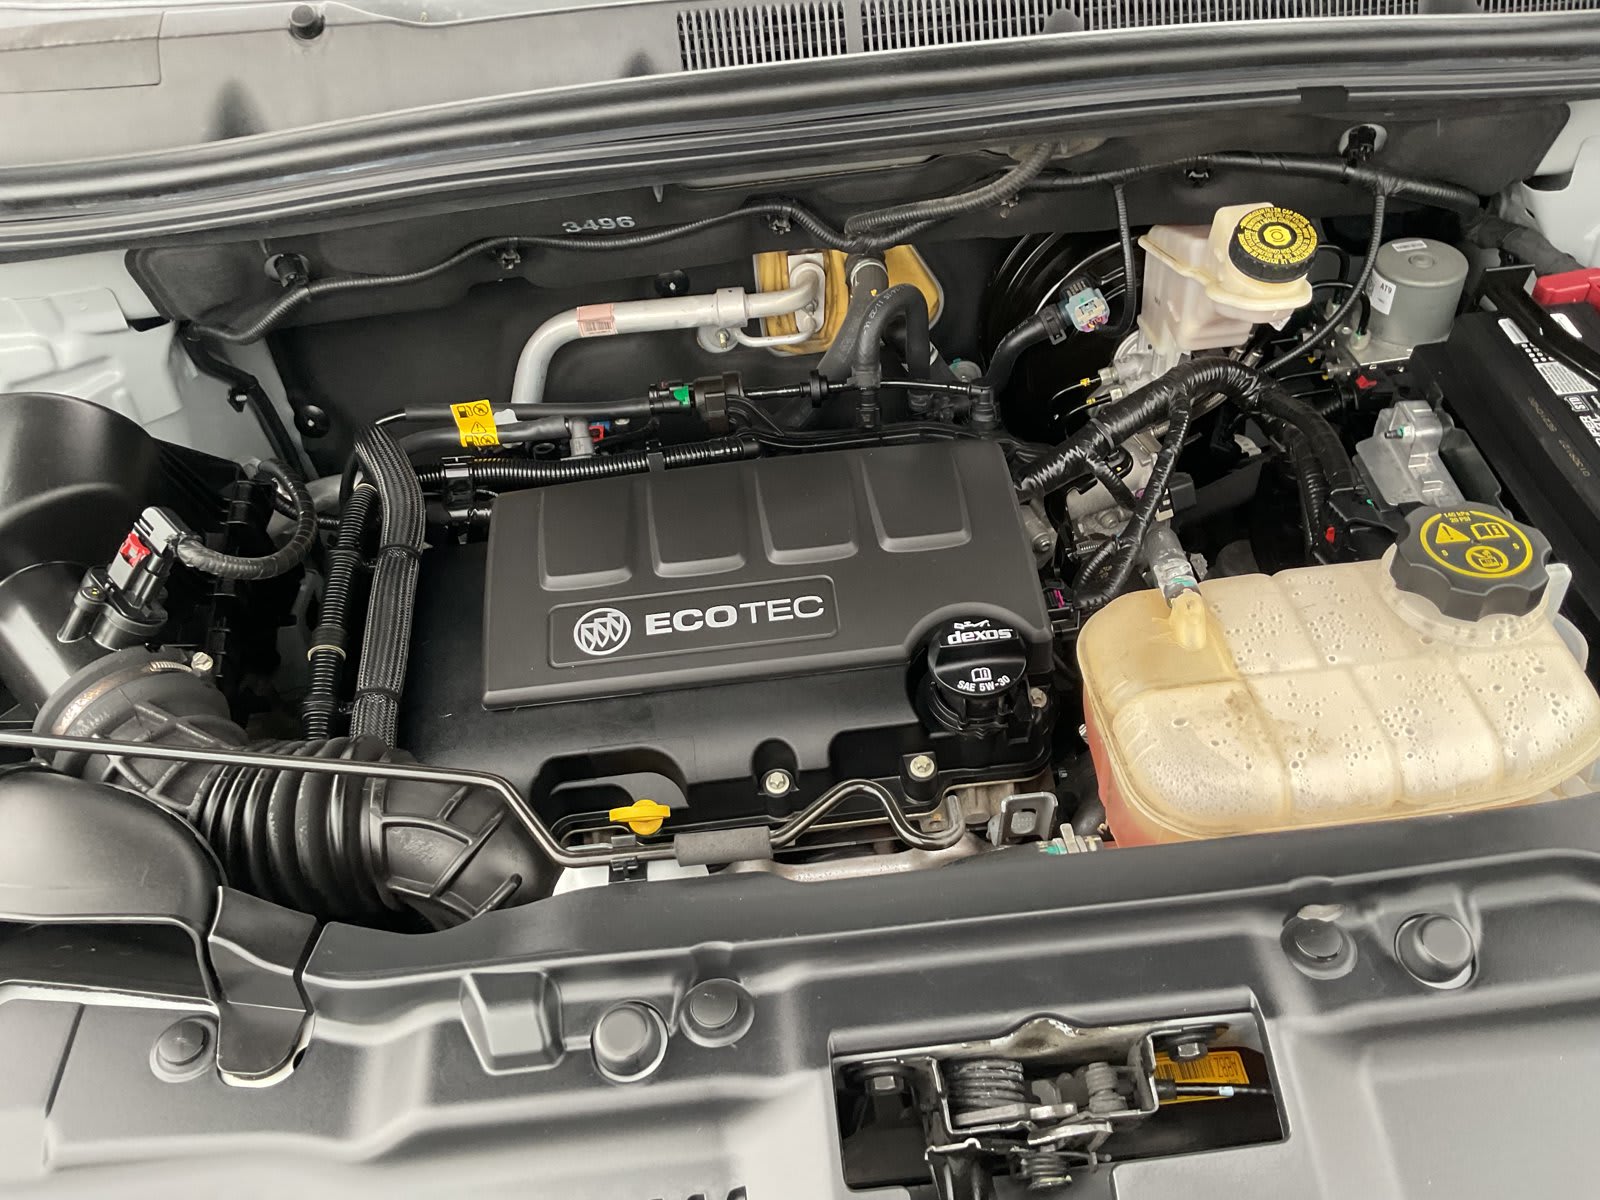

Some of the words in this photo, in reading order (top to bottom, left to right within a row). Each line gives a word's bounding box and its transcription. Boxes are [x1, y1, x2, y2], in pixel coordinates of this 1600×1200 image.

[561, 216, 636, 233] 3496
[645, 595, 825, 636] ECOTEC
[947, 628, 1013, 645] dexos
[957, 680, 976, 692] SAE
[979, 675, 1011, 692] 5W-30
